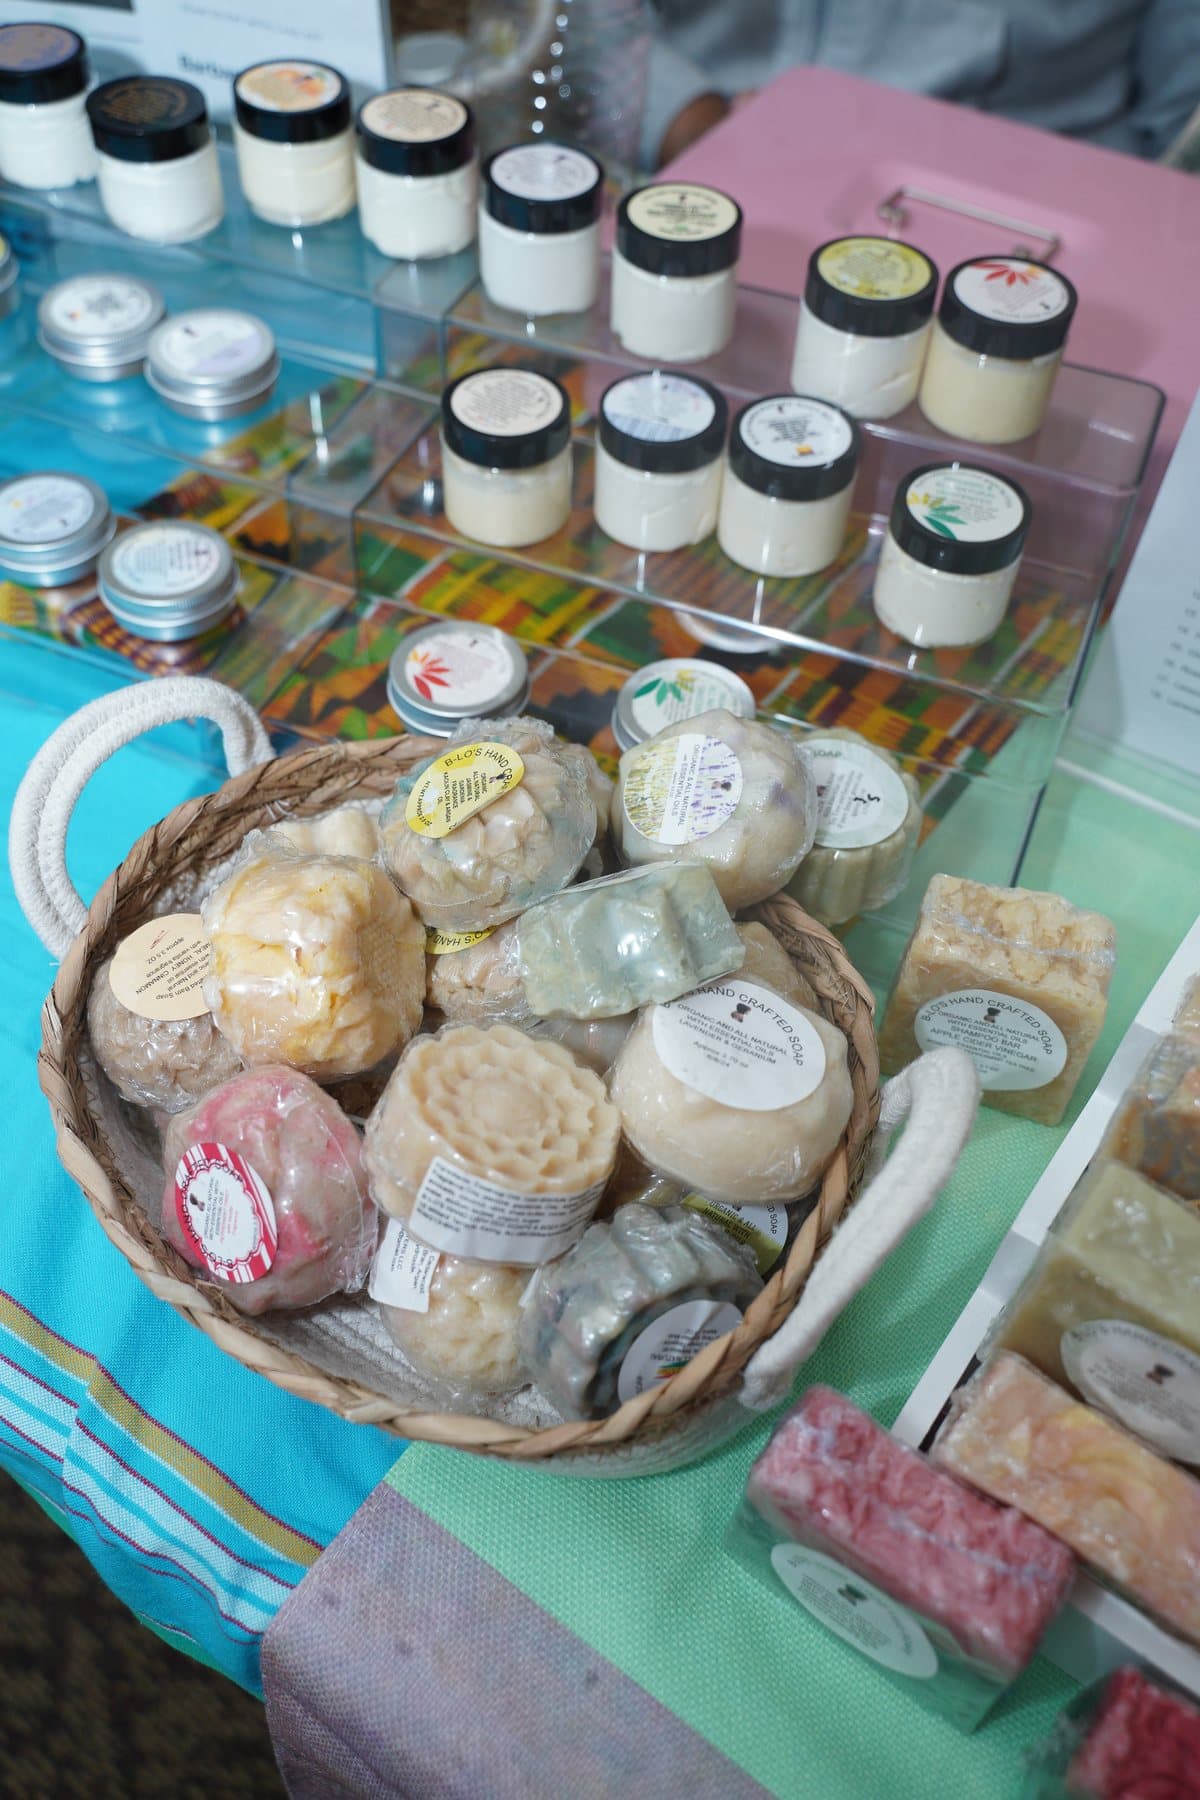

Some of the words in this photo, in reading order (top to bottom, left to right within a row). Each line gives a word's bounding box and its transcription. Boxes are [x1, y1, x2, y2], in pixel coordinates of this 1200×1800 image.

[445, 748, 482, 767] B-LO'S
[484, 749, 509, 768] HAND
[688, 744, 701, 776] ORGANIC
[675, 763, 688, 799] ESSENTIAL
[672, 800, 680, 817] OILS
[678, 796, 690, 827] NATURAL
[166, 937, 185, 952] approx
[190, 940, 202, 950] with
[433, 935, 460, 946] HAND
[147, 956, 157, 965] OZ
[172, 948, 190, 961] vanilla
[172, 955, 193, 972] HONEY
[146, 960, 173, 978] fragrance
[175, 961, 199, 979] essential
[189, 969, 199, 979] and
[136, 970, 170, 995] CINNAMON
[168, 977, 189, 992] Natural
[175, 986, 191, 996] Bath
[156, 992, 175, 1000] Soap
[678, 1004, 716, 1024] ORGANIC
[716, 1021, 735, 1034] AND
[735, 1029, 749, 1039] ALL
[750, 1036, 788, 1057] NATURAL
[687, 1014, 709, 1027] WITH
[709, 1022, 754, 1047] ESSENTIAL
[754, 1045, 774, 1057] OILS
[697, 986, 736, 998] HAND
[739, 994, 794, 1034] CRAFTED
[788, 1035, 804, 1067] SOAP
[921, 1002, 948, 1023] B-LO'S
[949, 996, 984, 1006] HAND
[987, 999, 1041, 1029] CRAFTED
[1038, 1030, 1053, 1055] SOAP
[938, 1010, 973, 1024] ORGANIC
[974, 1019, 990, 1028] AND
[990, 1024, 1005, 1032] ALL
[1006, 1028, 1042, 1043] NATURAL
[948, 1019, 968, 1027] WITH
[968, 1023, 1010, 1037] ESSENTIAL
[1010, 1034, 1028, 1044] OILS
[680, 1019, 723, 1042] LAVENDER
[731, 1042, 777, 1065] GERANIUM
[930, 1027, 961, 1040] APPLE
[963, 1036, 993, 1049] CIDER
[994, 1045, 1038, 1063] VINEGAR
[951, 1026, 999, 1043] SHAMPOO
[1001, 1039, 1021, 1050] BAR
[704, 1208, 730, 1227] NATURAL
[710, 1200, 739, 1218] ORGANIC
[744, 1221, 756, 1229] ALL
[770, 1213, 778, 1235] SOAP
